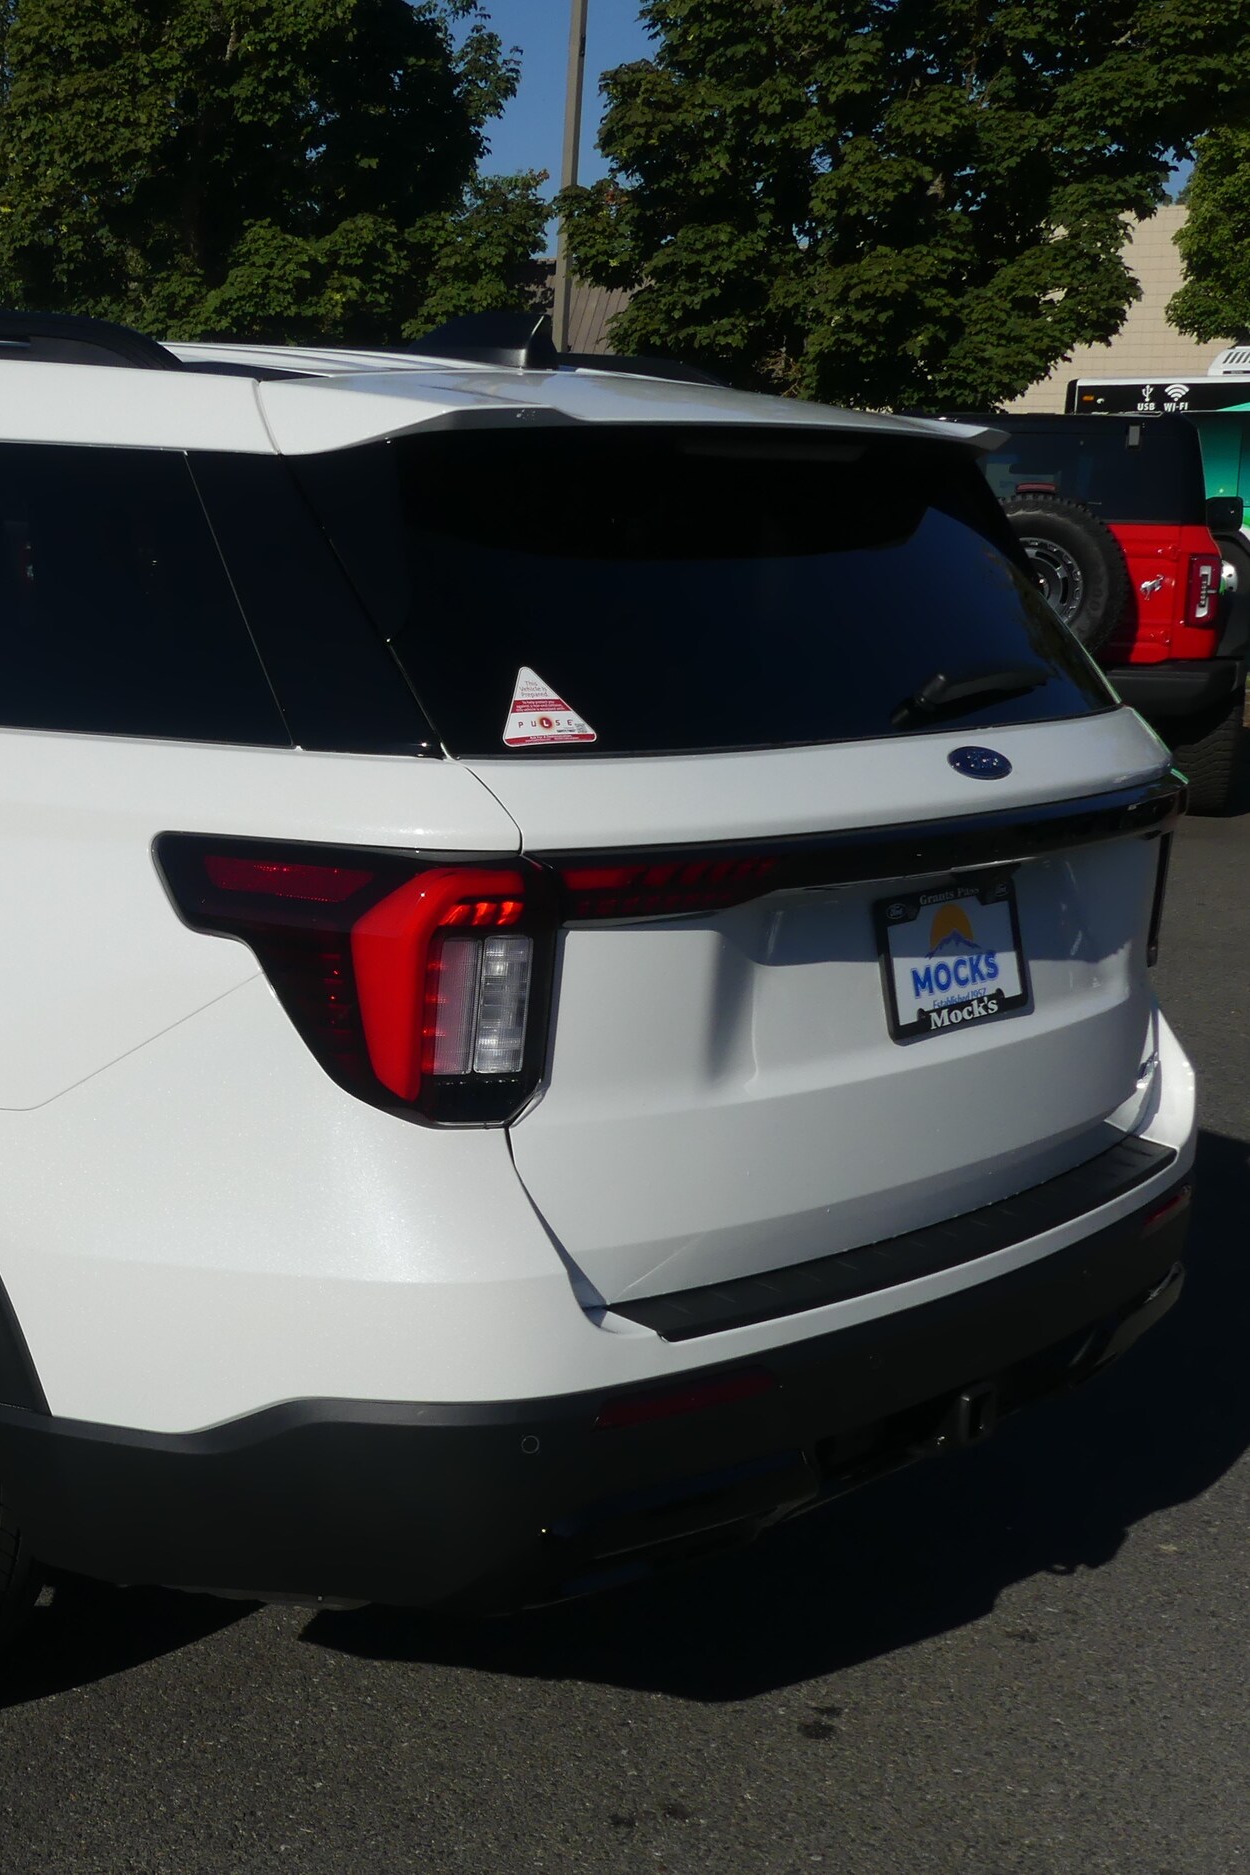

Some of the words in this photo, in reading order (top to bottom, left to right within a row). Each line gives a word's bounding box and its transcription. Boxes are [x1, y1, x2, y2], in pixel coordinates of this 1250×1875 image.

[1137, 402, 1155, 411] USB
[1163, 402, 1188, 412] WI-FI
[919, 890, 955, 905] Grants
[957, 887, 980, 898] Pass
[910, 951, 999, 999] MOCKS
[969, 987, 987, 1000] 1957
[929, 996, 999, 1030] Mock's
